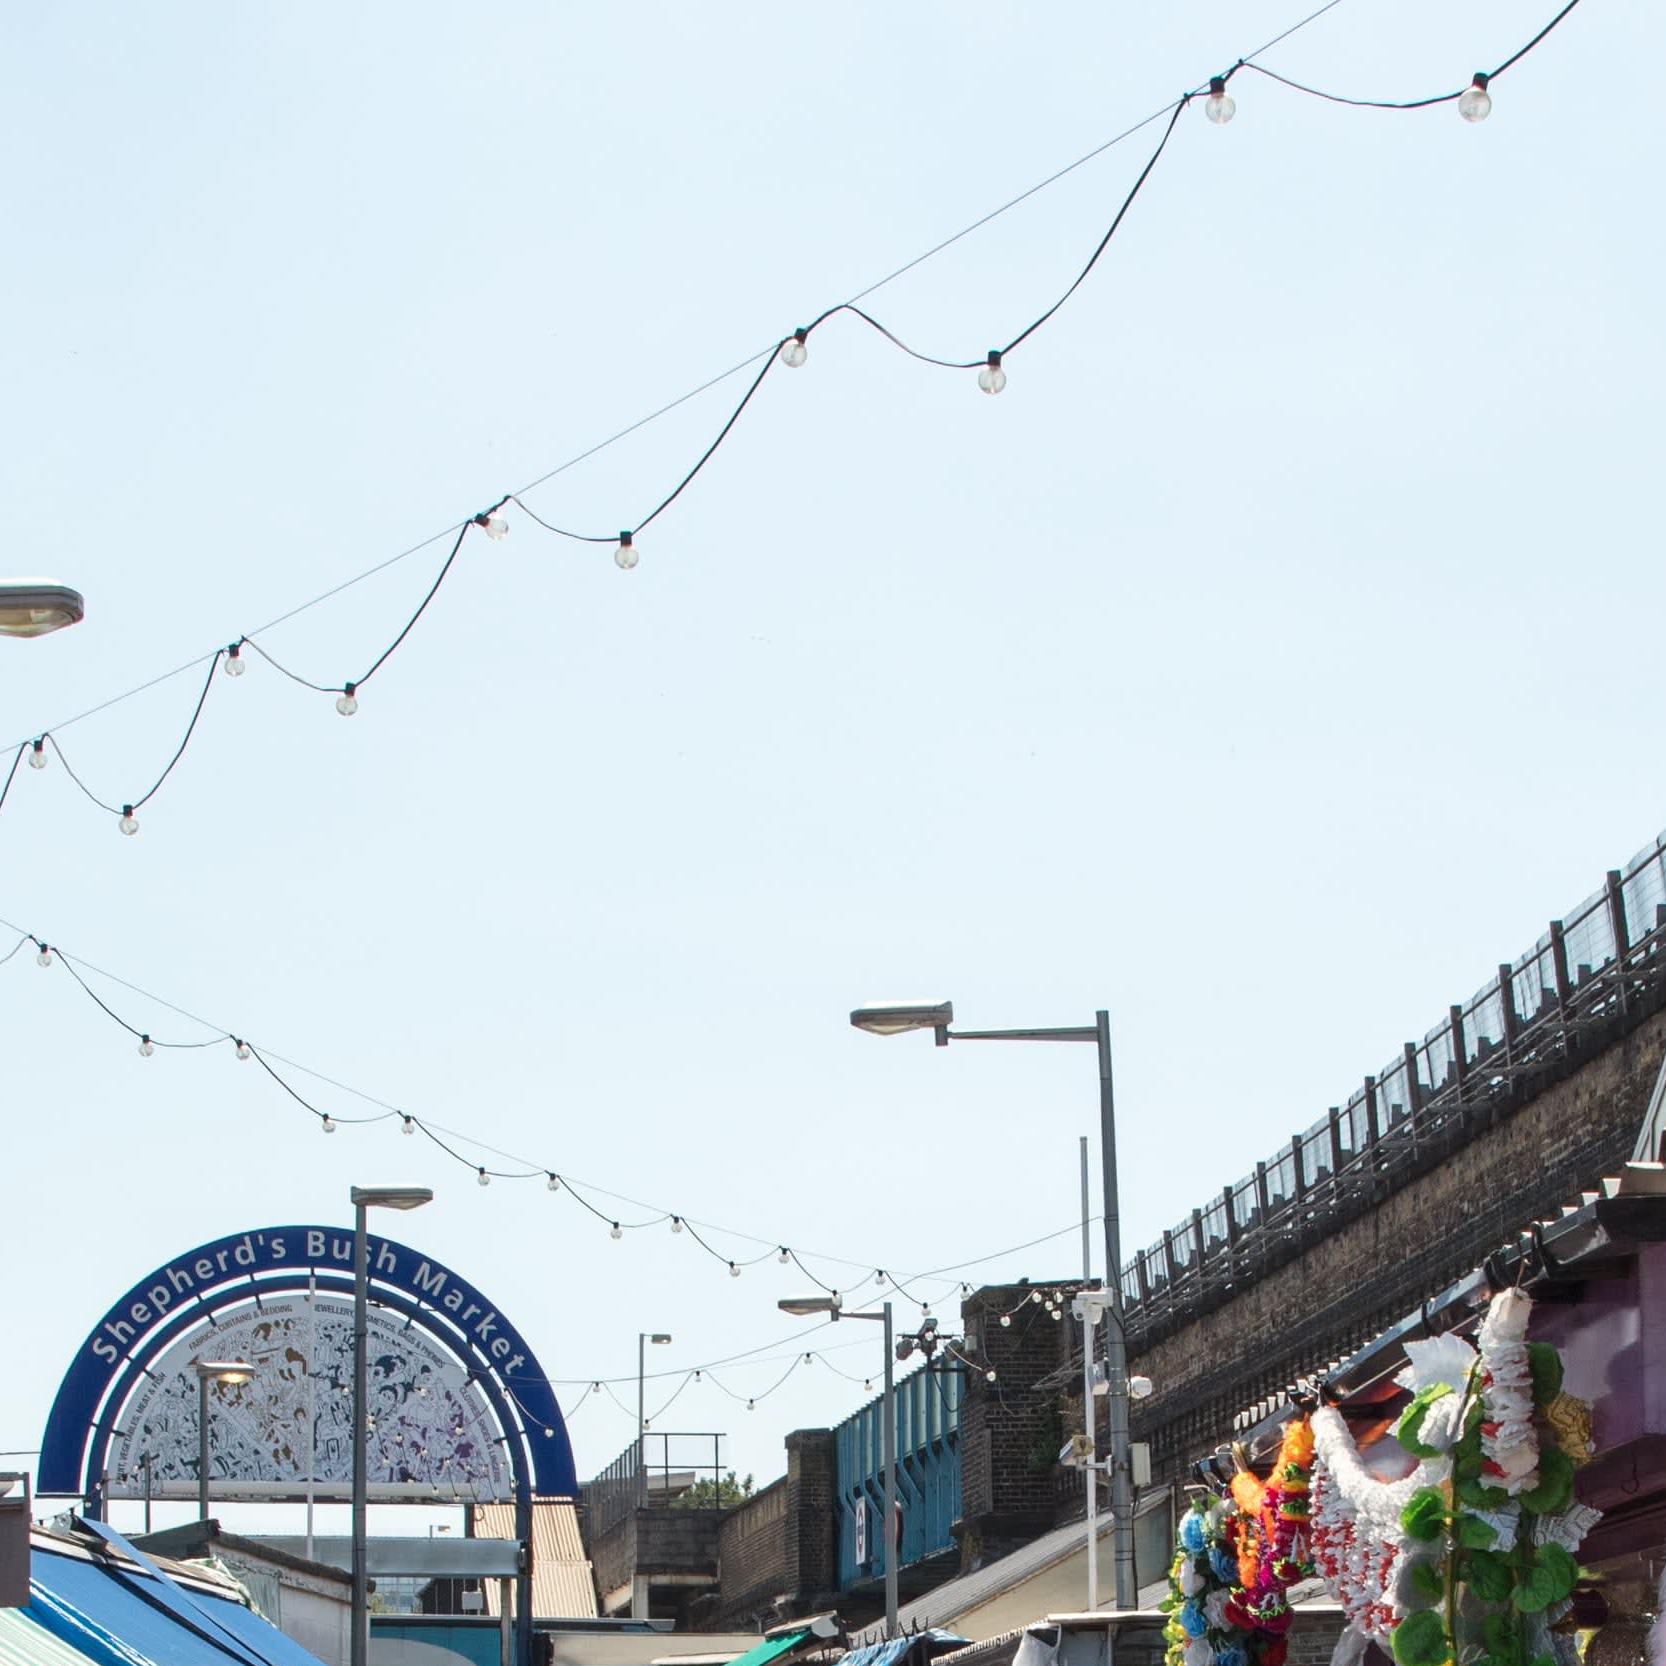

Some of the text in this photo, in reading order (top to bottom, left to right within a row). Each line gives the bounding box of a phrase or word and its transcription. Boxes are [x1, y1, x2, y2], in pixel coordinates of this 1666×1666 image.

[92, 1230, 527, 1376] Shepherd's Bush Market
